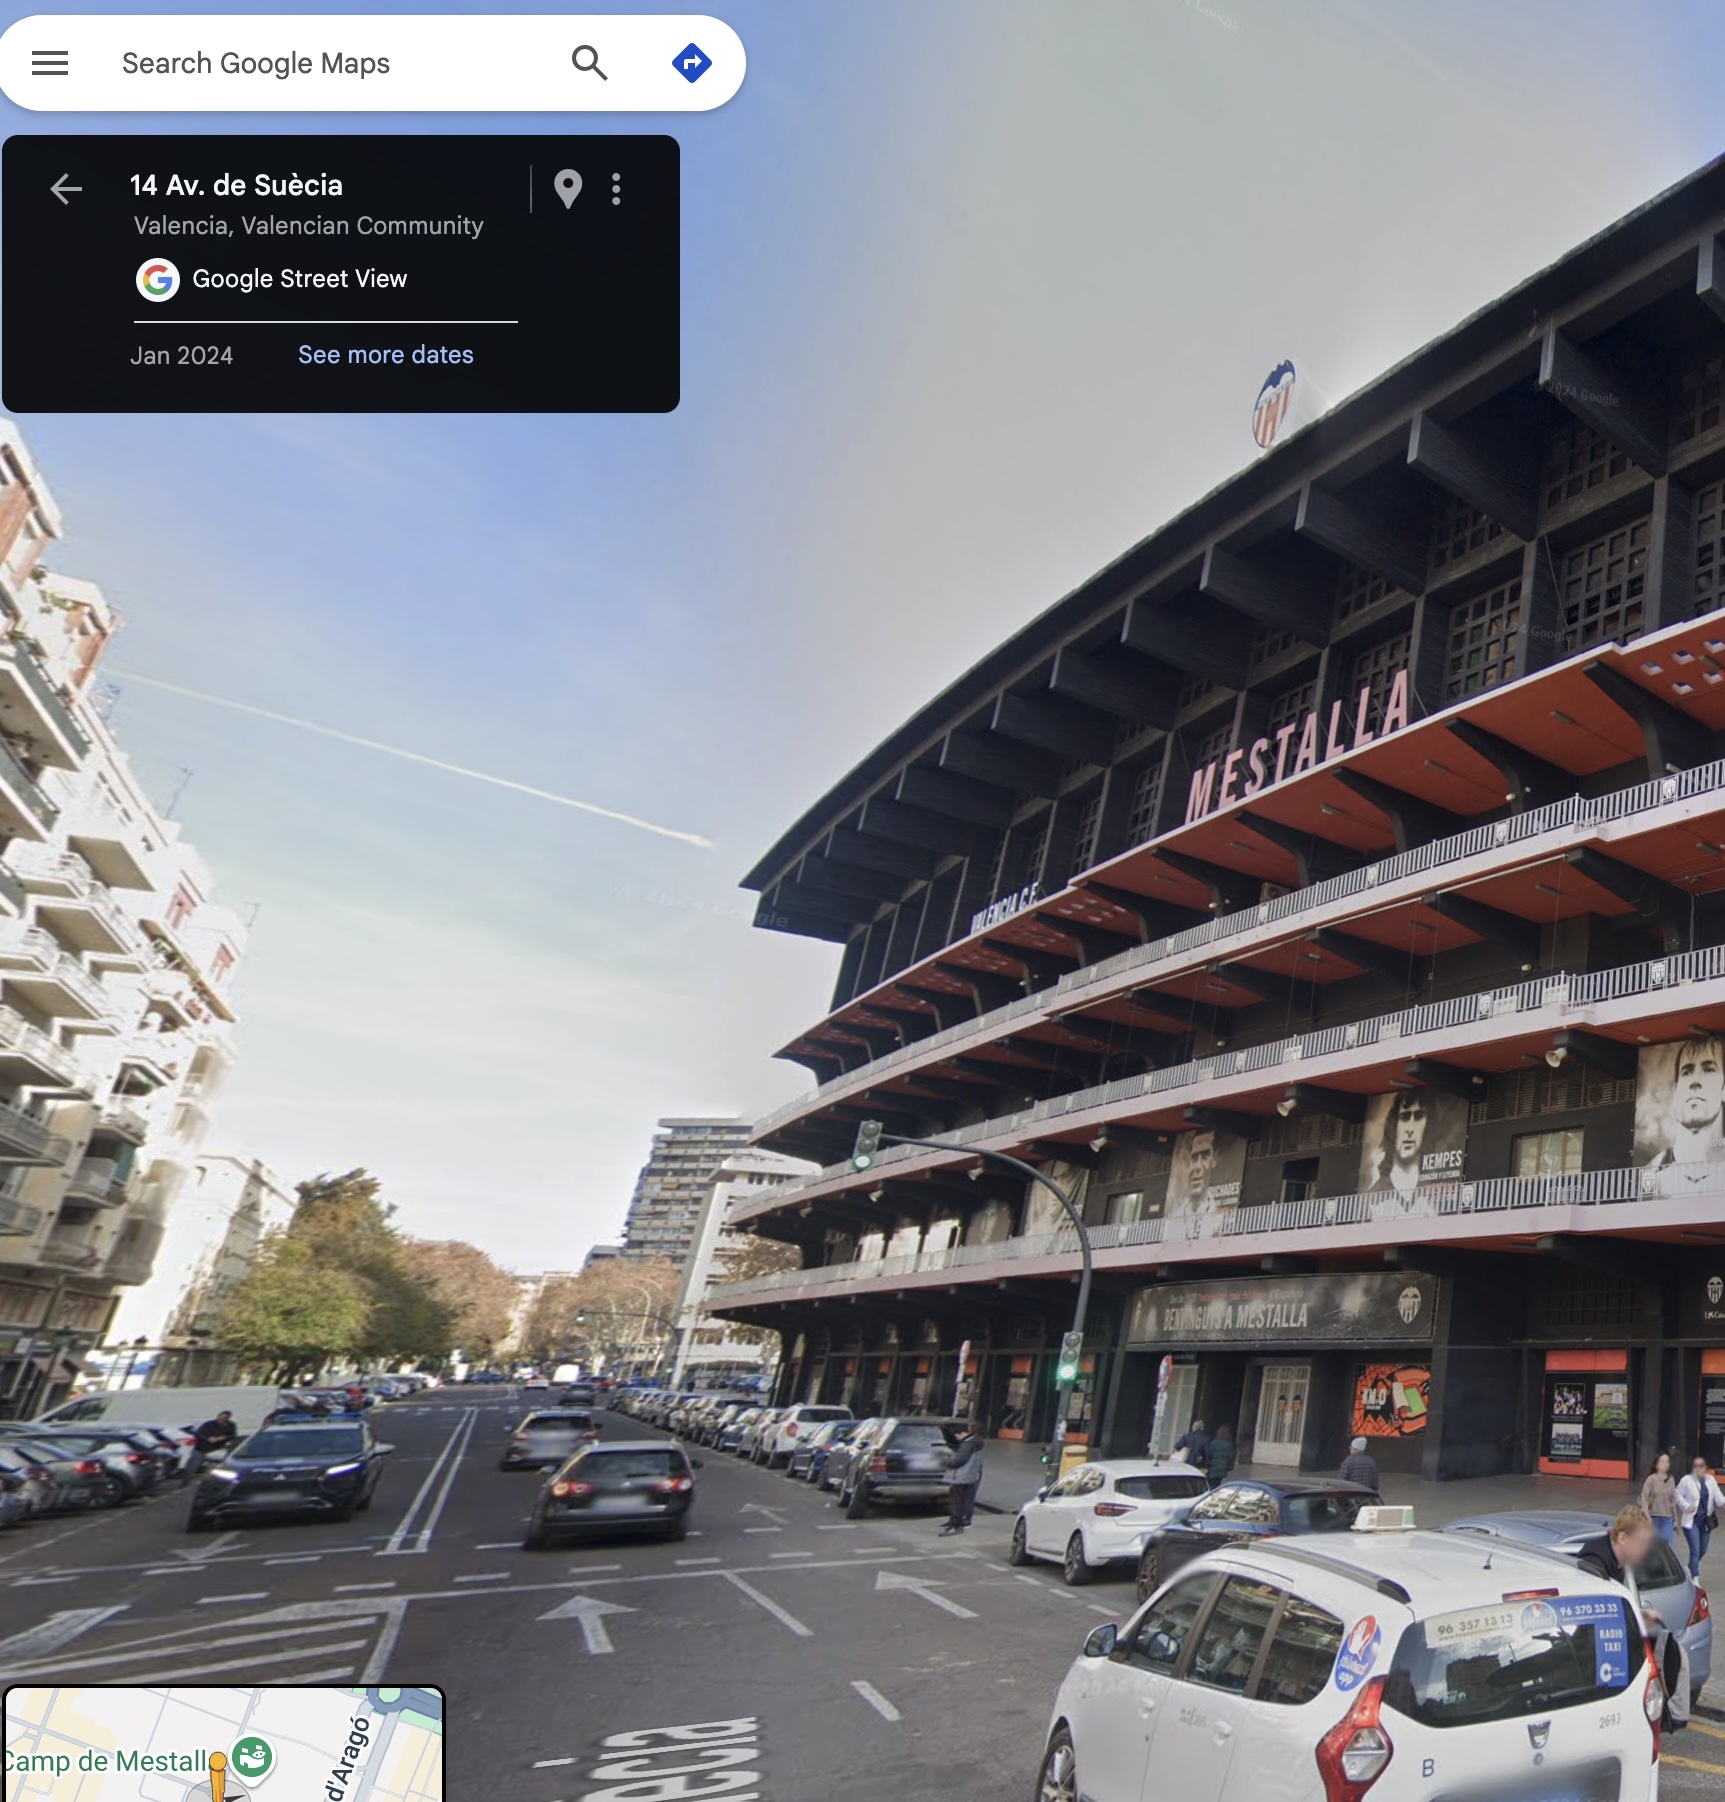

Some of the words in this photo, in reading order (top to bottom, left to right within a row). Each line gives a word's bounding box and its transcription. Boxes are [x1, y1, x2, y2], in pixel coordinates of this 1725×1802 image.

[1185, 669, 1408, 825] MESTALLA
[1422, 1149, 1463, 1170] KEMPES
[1223, 1304, 1232, 1330] A
[1235, 1302, 1308, 1329] MESTALLA
[1560, 1606, 1572, 1617] 96
[1574, 1604, 1593, 1615] 370
[1594, 1603, 1606, 1613] 33
[1607, 1602, 1618, 1613] 33
[1438, 1624, 1453, 1636] 96
[1459, 1619, 1480, 1632] 357
[1484, 1615, 1498, 1628] 13
[1501, 1613, 1514, 1625] 13
[1599, 1629, 1624, 1639] RADIO
[1604, 1642, 1621, 1652] TAXI
[1599, 1712, 1622, 1730] 2693
[1422, 1758, 1436, 1778] B
